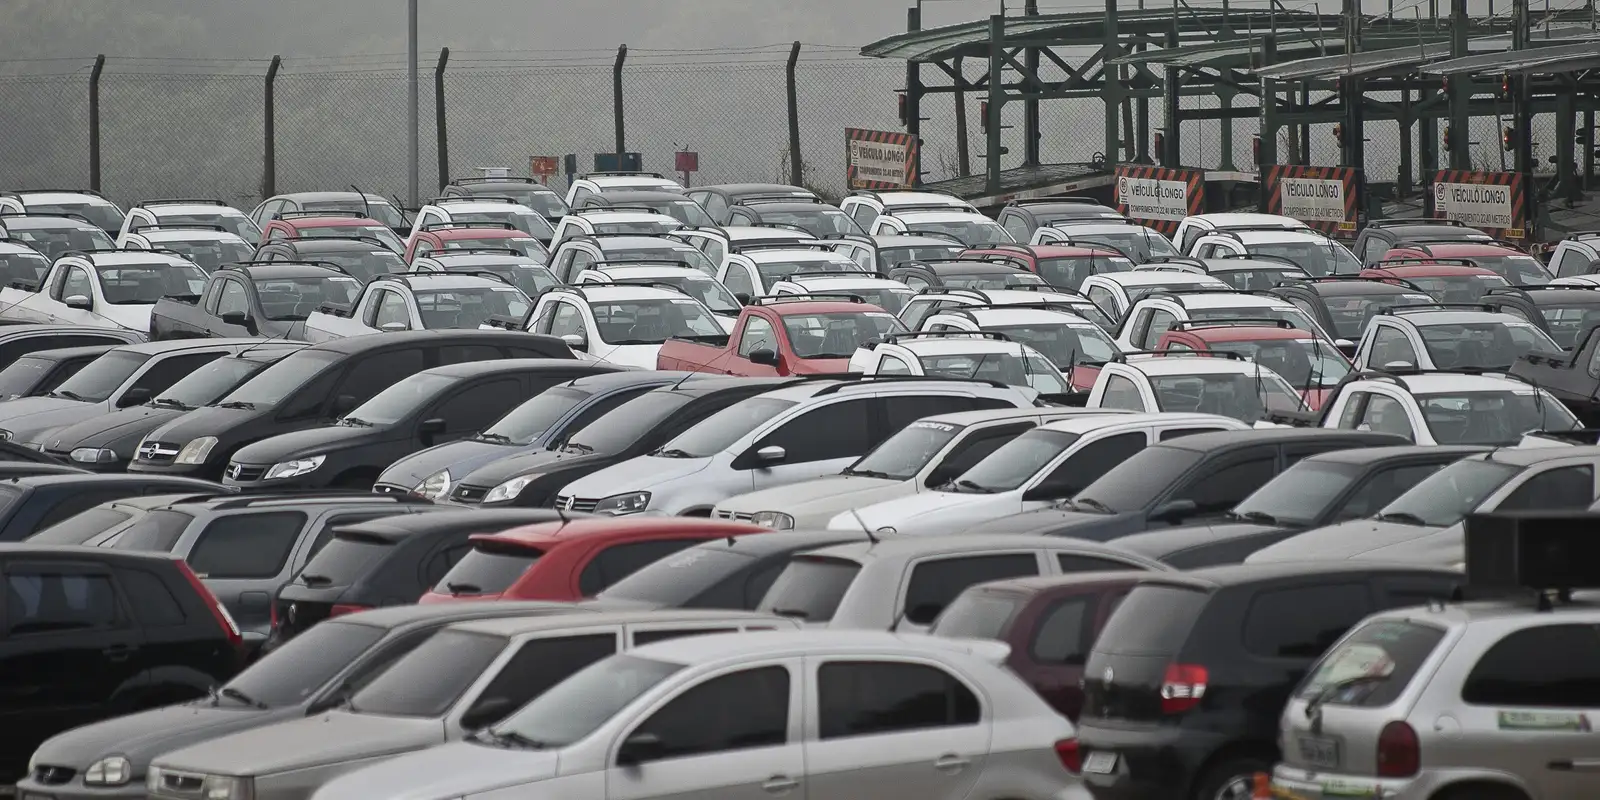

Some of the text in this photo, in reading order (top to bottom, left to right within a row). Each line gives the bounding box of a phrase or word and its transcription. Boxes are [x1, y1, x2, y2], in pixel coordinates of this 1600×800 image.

[884, 149, 905, 163] LONGO
[1160, 188, 1184, 199] LONGO
[1316, 185, 1339, 198] LONGO
[1481, 189, 1506, 204] LONGO
[1130, 204, 1159, 214] COMPRIMENTO
[1170, 207, 1187, 216] METROS
[1284, 206, 1314, 216] COMPRIMENTO
[1325, 208, 1344, 218] METROS
[1449, 212, 1480, 222] COMPRIMENTO
[1492, 214, 1511, 225] METROS
